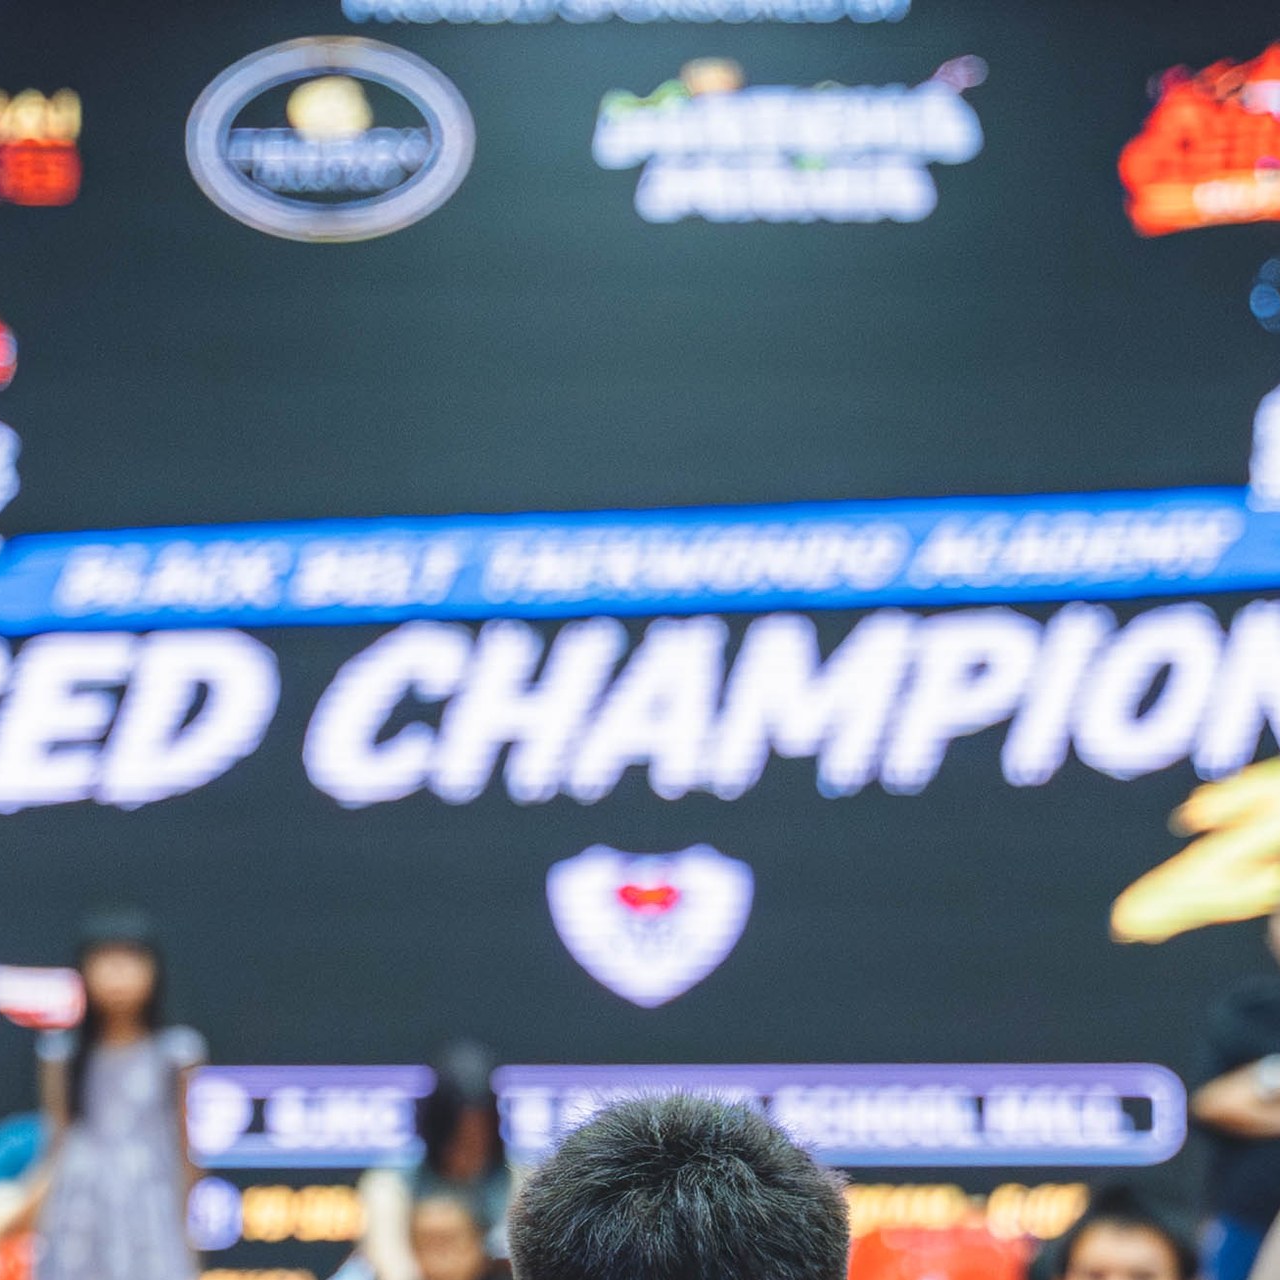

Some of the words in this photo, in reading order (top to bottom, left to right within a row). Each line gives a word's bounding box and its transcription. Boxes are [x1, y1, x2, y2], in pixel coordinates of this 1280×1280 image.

[56, 540, 280, 616] BLACK
[293, 534, 460, 608] BELT
[483, 522, 910, 602] TAEKWONDO
[914, 509, 1242, 590] ACADEMY
